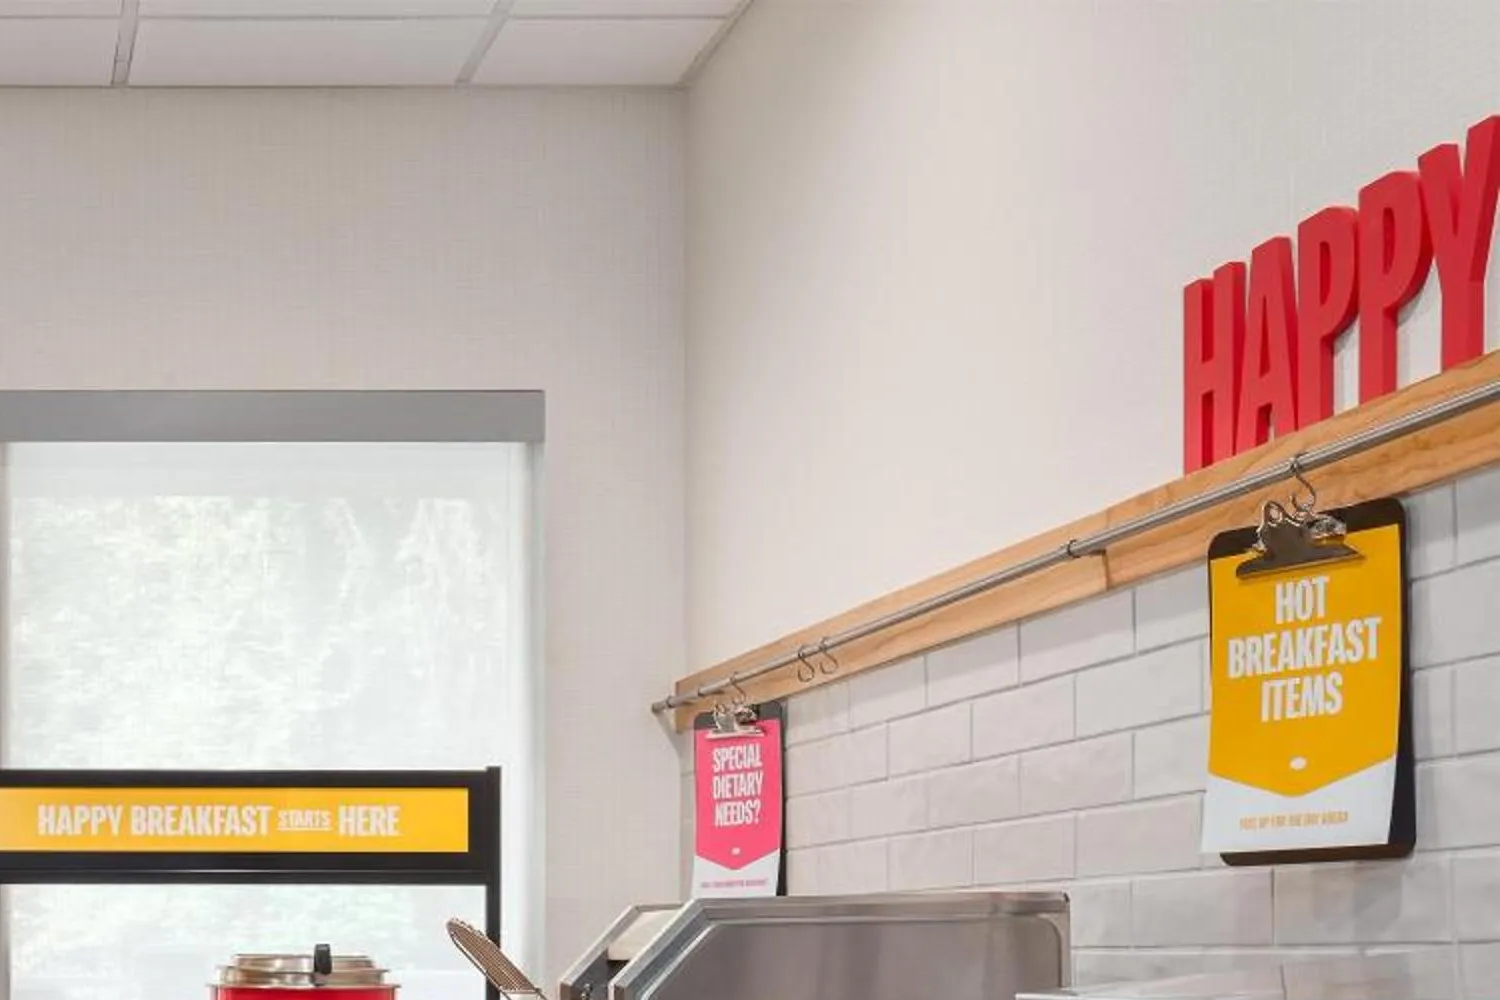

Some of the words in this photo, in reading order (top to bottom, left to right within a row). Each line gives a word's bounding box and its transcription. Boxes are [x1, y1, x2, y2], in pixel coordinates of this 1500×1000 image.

[1183, 115, 1500, 476] HAPPY
[1274, 575, 1330, 625] HOT
[1227, 616, 1382, 679] BREAKFAST
[1261, 672, 1343, 723] ITEMS
[712, 743, 763, 773] SPECIAL
[712, 771, 764, 800] DIETARY
[38, 804, 122, 836] HAPPY
[131, 804, 273, 837] BREAKFAST
[277, 809, 331, 829] STARTS
[339, 805, 400, 837] HERE
[715, 799, 761, 828] NEEDS?
